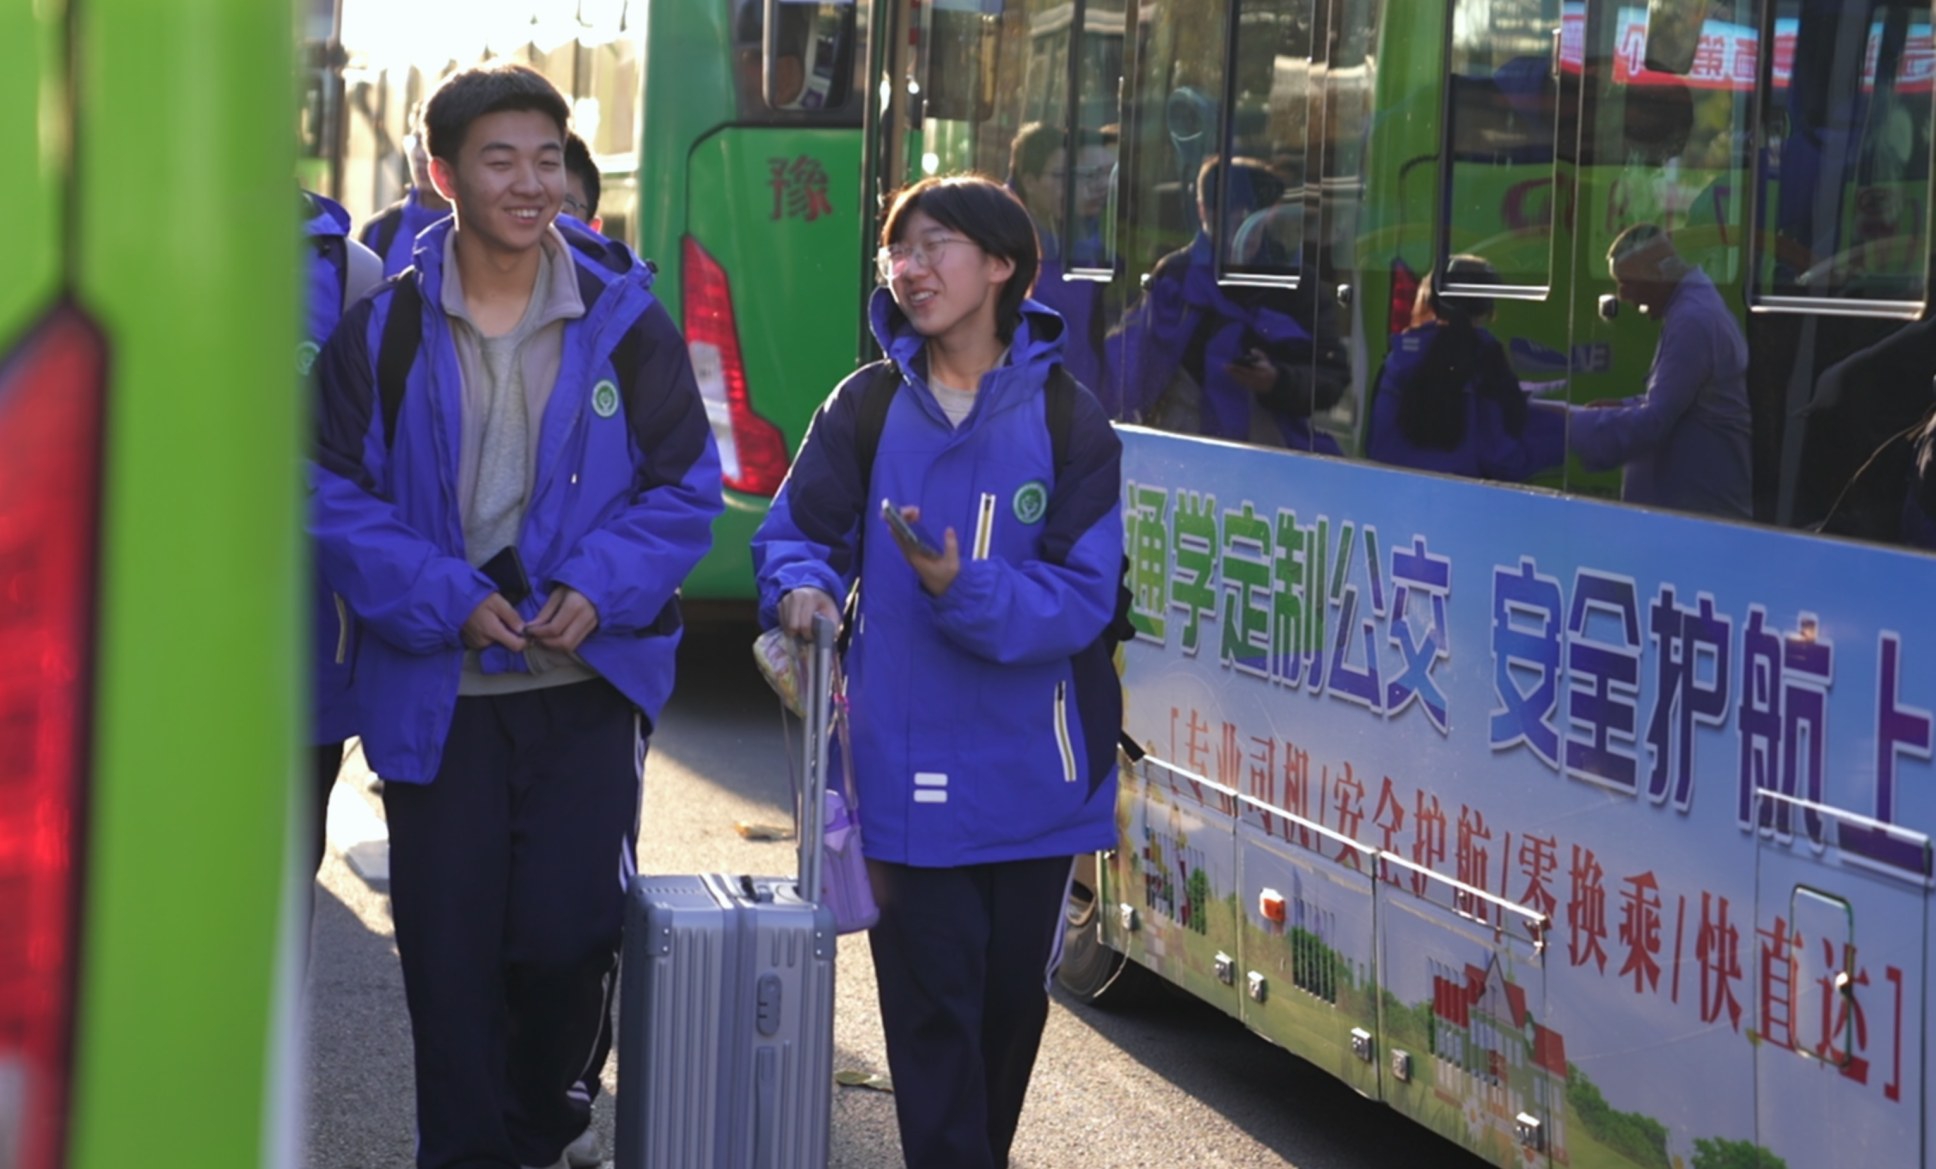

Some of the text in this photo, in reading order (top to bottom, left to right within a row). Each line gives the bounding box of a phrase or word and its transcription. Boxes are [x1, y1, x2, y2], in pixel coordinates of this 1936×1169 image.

[766, 155, 832, 221] 豫
[1125, 479, 1932, 885] 通学定制公交 安全护航上
